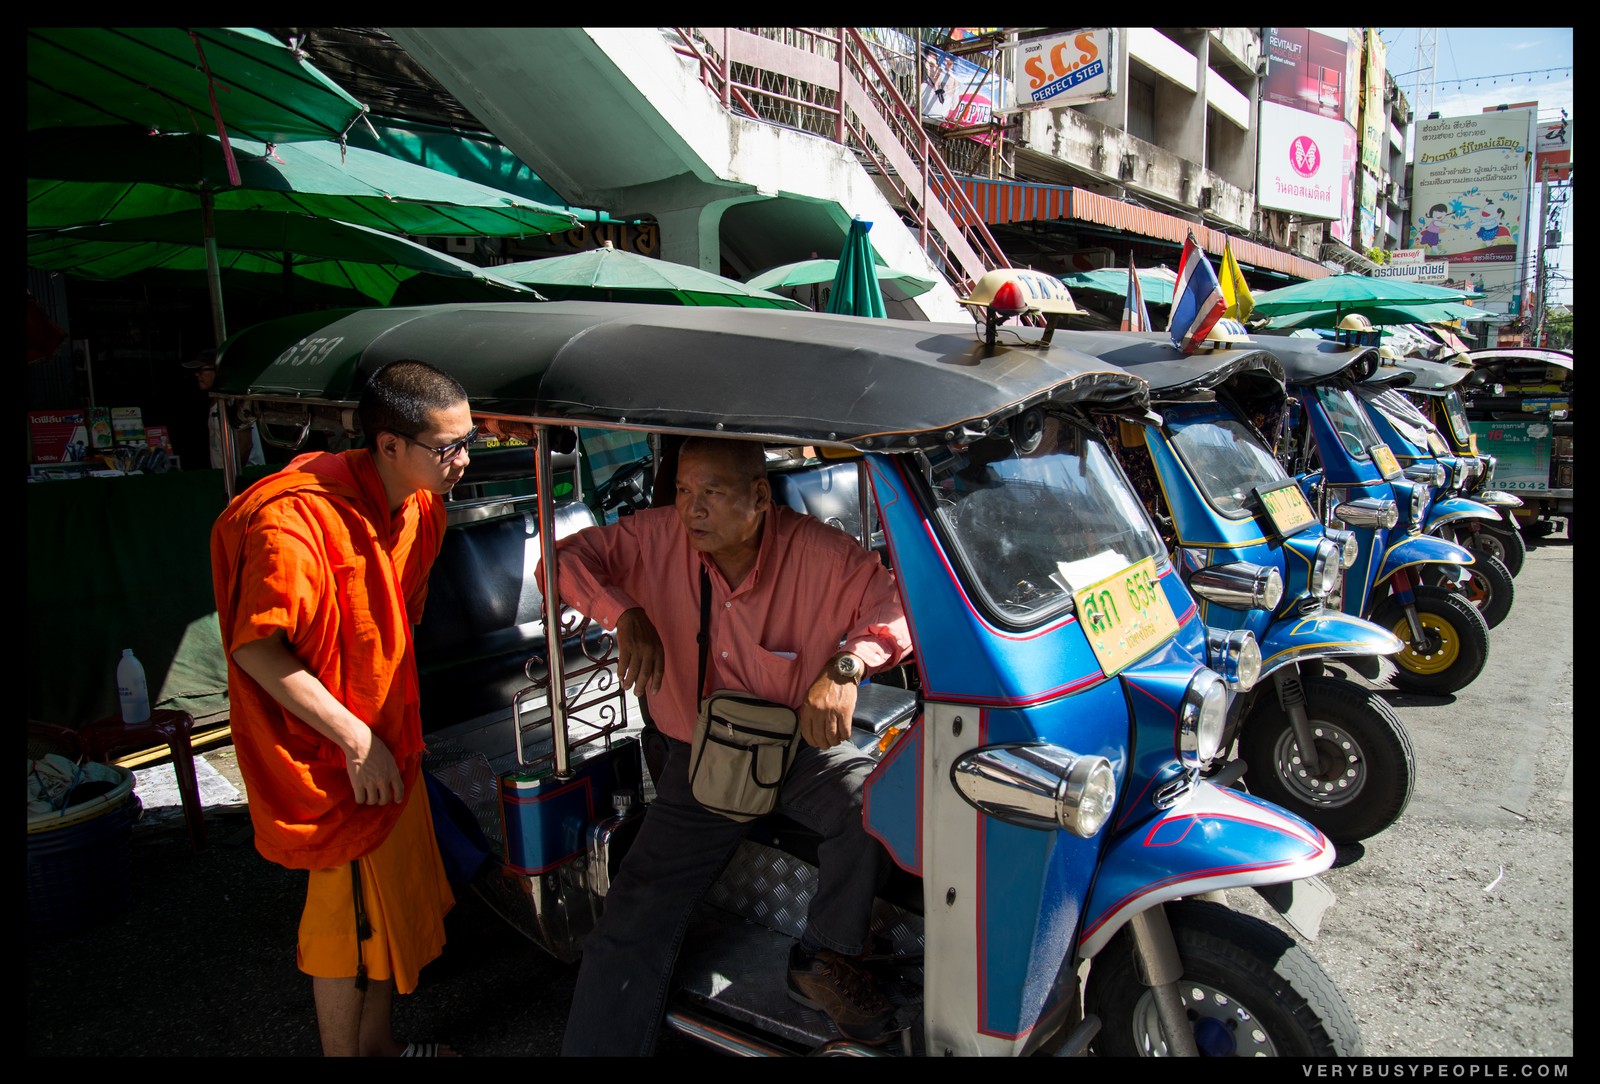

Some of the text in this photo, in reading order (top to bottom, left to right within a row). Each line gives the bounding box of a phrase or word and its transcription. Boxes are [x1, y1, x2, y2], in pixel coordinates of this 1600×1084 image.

[1024, 32, 1099, 89] S.C.S
[1269, 36, 1303, 54] REVITALIFT
[1032, 62, 1101, 102] PERFECT STEP
[1487, 429, 1504, 441] 16
[1126, 569, 1157, 611] 659
